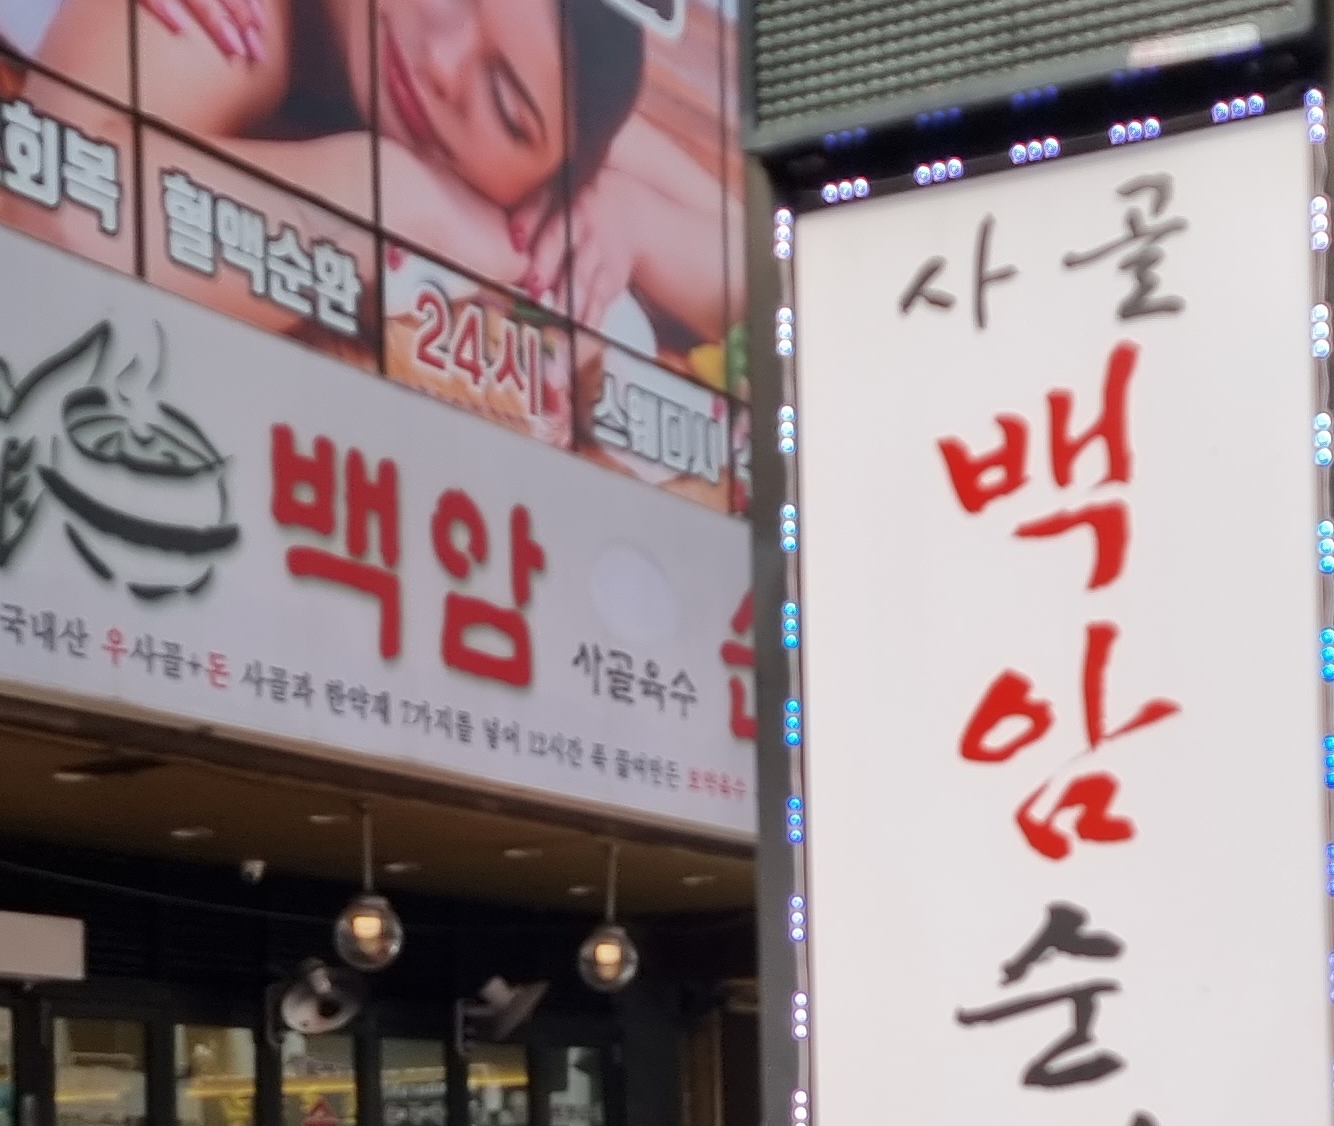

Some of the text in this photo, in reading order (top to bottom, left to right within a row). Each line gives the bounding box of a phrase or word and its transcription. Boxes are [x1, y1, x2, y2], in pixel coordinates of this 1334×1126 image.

[161, 170, 361, 335] 혈액순환
[899, 172, 1188, 330] 사골
[417, 287, 541, 418] 24시
[270, 422, 546, 688] 백암
[573, 643, 698, 719] 사골육수
